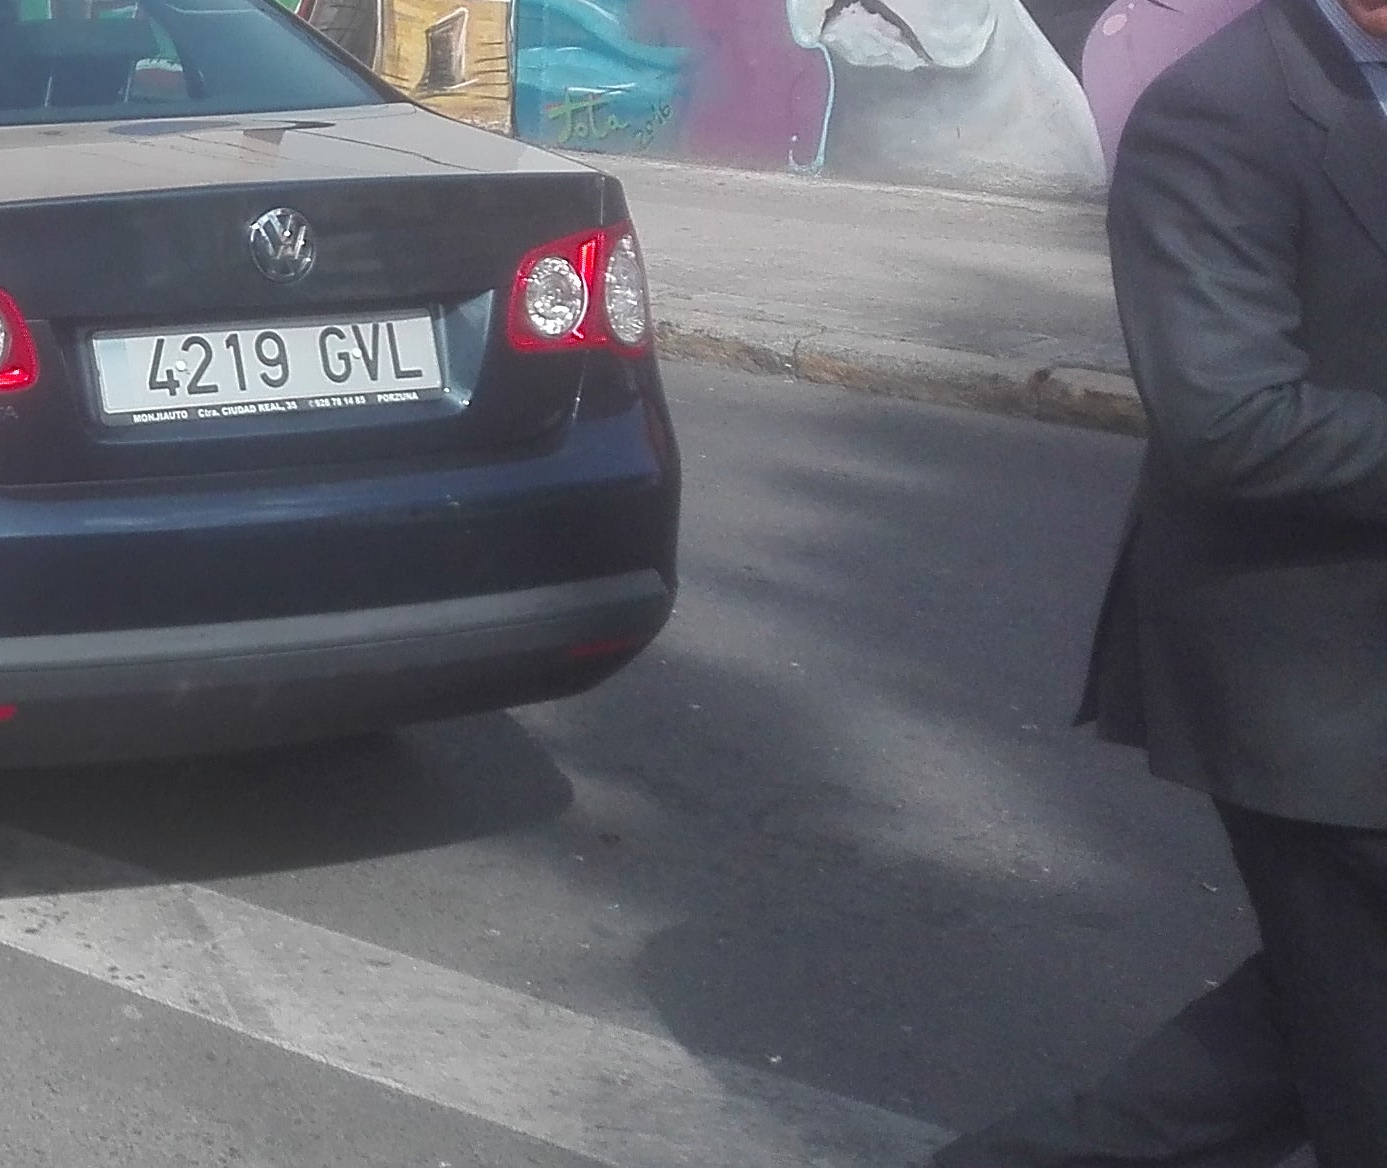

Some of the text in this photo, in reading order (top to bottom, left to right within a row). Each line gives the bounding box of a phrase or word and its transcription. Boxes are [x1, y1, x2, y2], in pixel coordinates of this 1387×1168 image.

[148, 322, 423, 397] 4219 GVL
[132, 409, 188, 423] MONJIAUTO
[221, 404, 257, 416] CIUDAD
